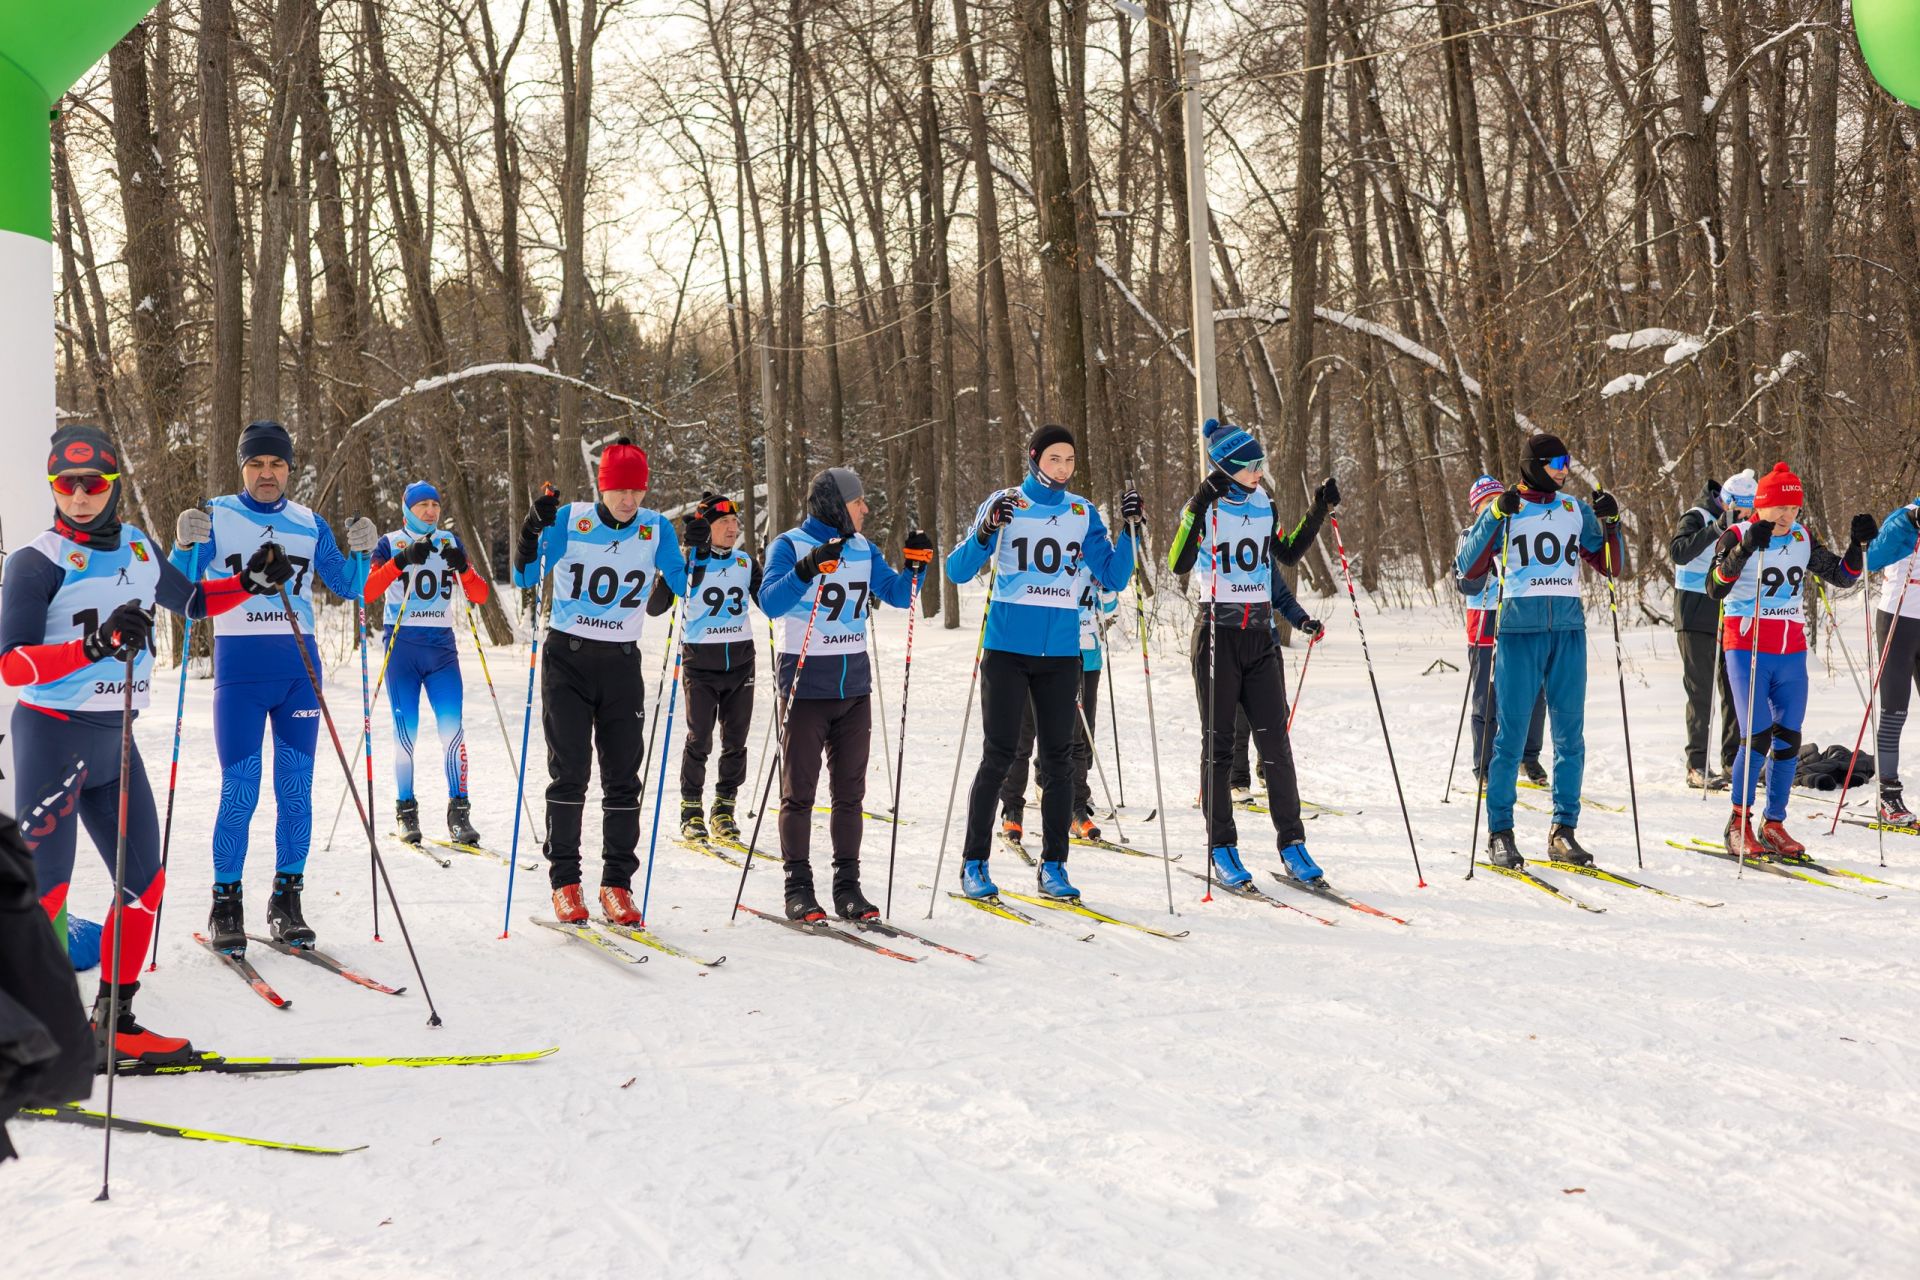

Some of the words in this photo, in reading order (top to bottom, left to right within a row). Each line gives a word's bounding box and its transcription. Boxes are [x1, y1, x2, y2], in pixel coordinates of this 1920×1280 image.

[1011, 537, 1080, 576] 103
[1512, 531, 1579, 567] 106
[225, 553, 310, 595] 17
[1530, 577, 1573, 586] ЗАИНСК
[1761, 566, 1803, 597] 99
[398, 569, 453, 600] 105
[569, 563, 646, 608] 102
[1026, 585, 1071, 597] ЗАИНСК
[1231, 583, 1266, 592] ЗАИНСК
[702, 586, 744, 616] 93
[820, 582, 867, 621] 97
[246, 611, 299, 622] ЗАИНСК
[410, 610, 446, 618] ЗАИНСК
[576, 614, 624, 630] ЗАИНСК
[706, 625, 743, 635] ЗАИНСК
[1551, 863, 1598, 878] FISCHER
[387, 1055, 502, 1063] FISCHER
[155, 1065, 202, 1073] FISCHER
